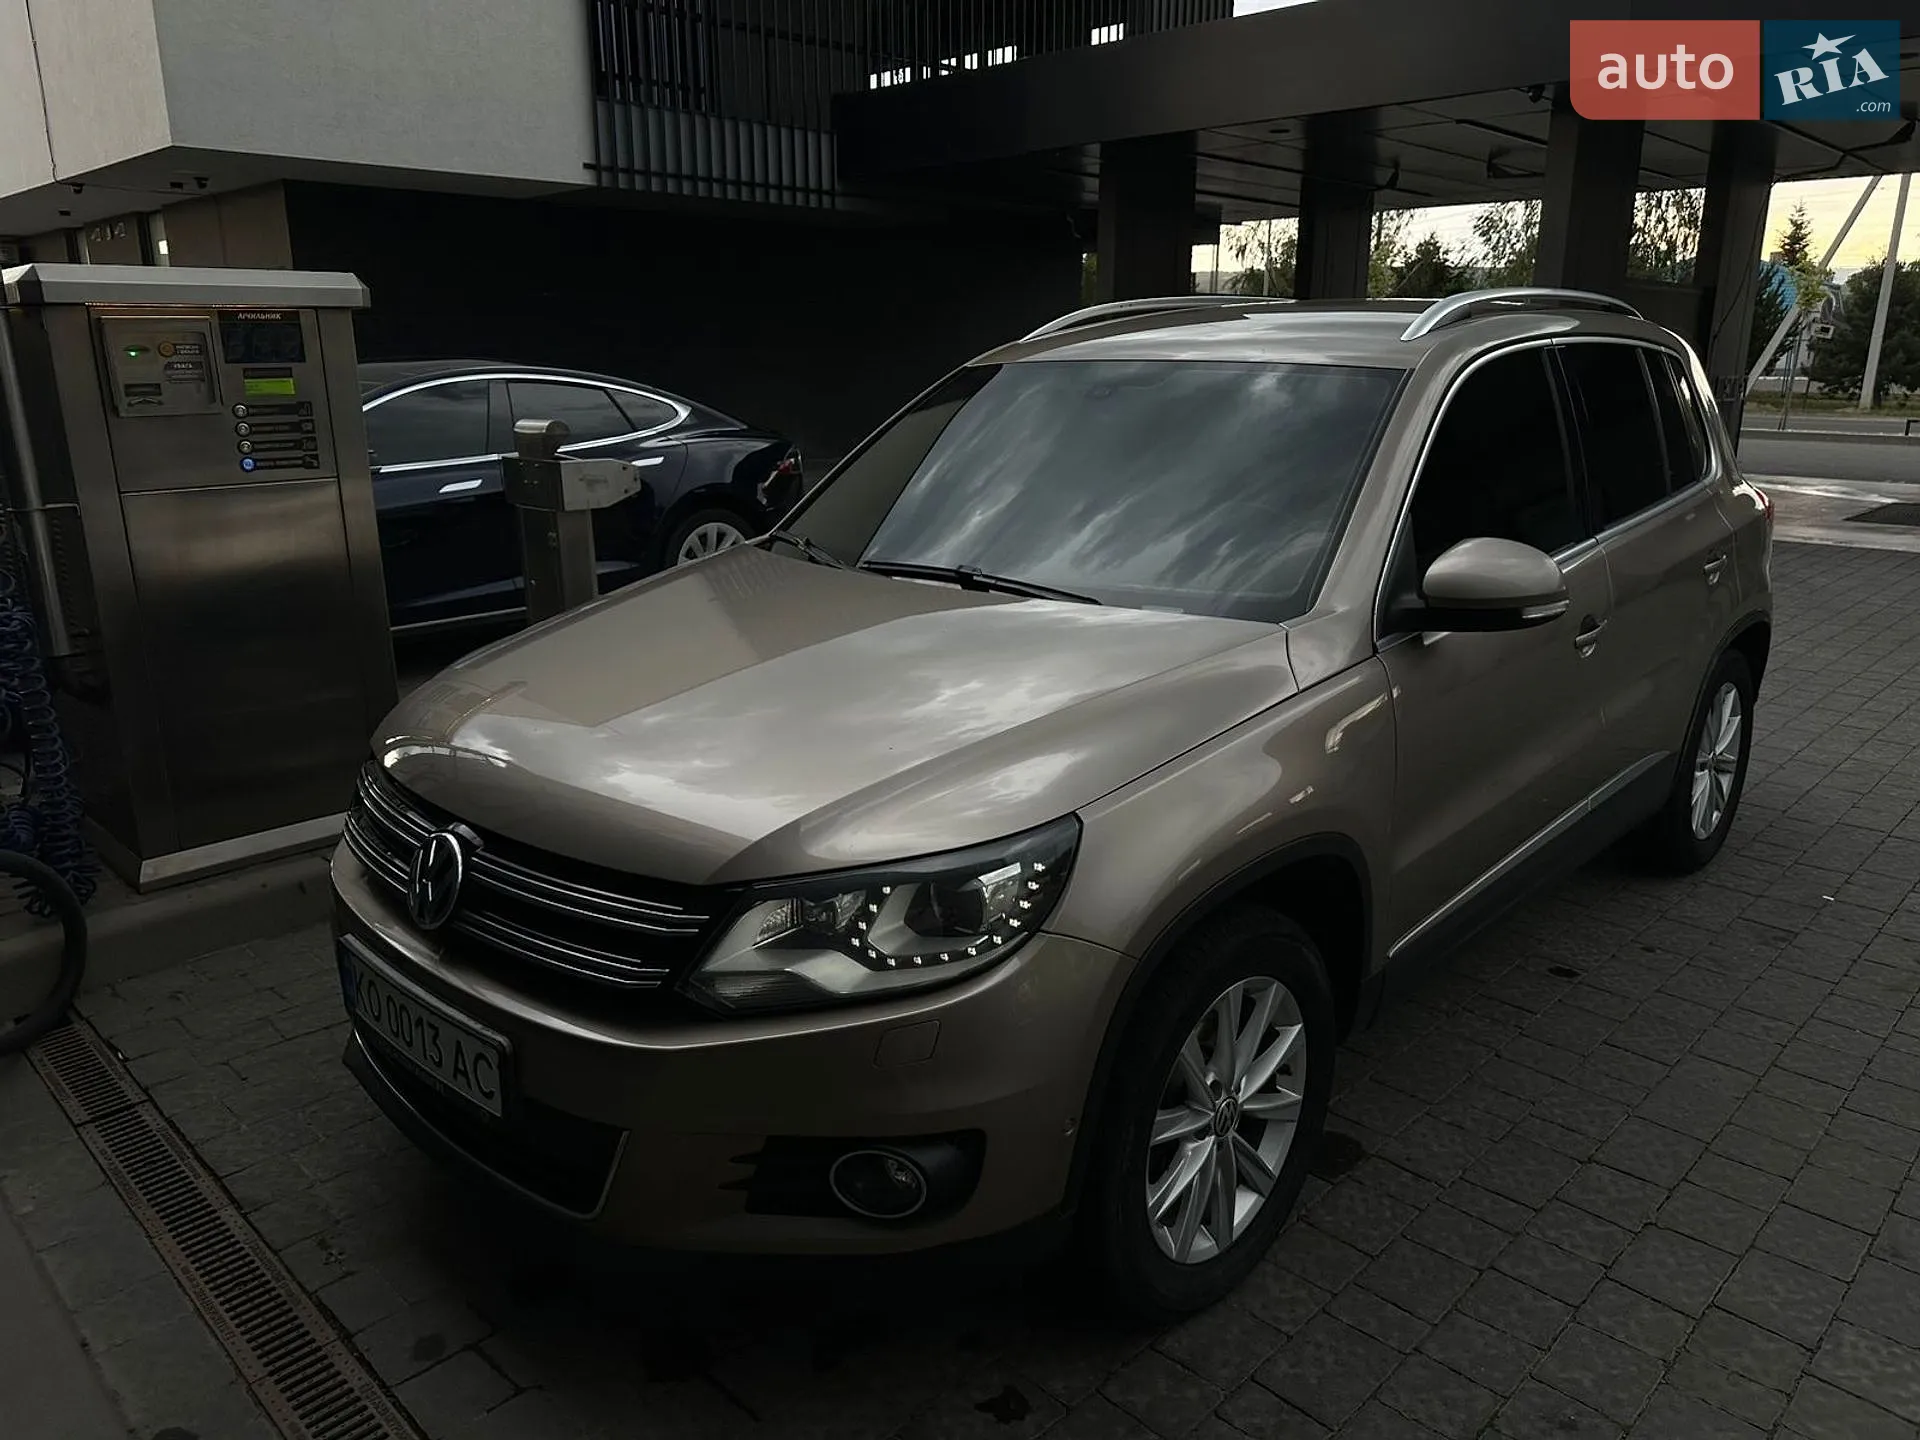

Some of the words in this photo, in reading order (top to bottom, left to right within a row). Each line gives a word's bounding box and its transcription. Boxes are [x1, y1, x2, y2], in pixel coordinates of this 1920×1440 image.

[355, 965, 382, 1023] KO
[386, 994, 444, 1068] 0013
[452, 1039, 496, 1100] AC
